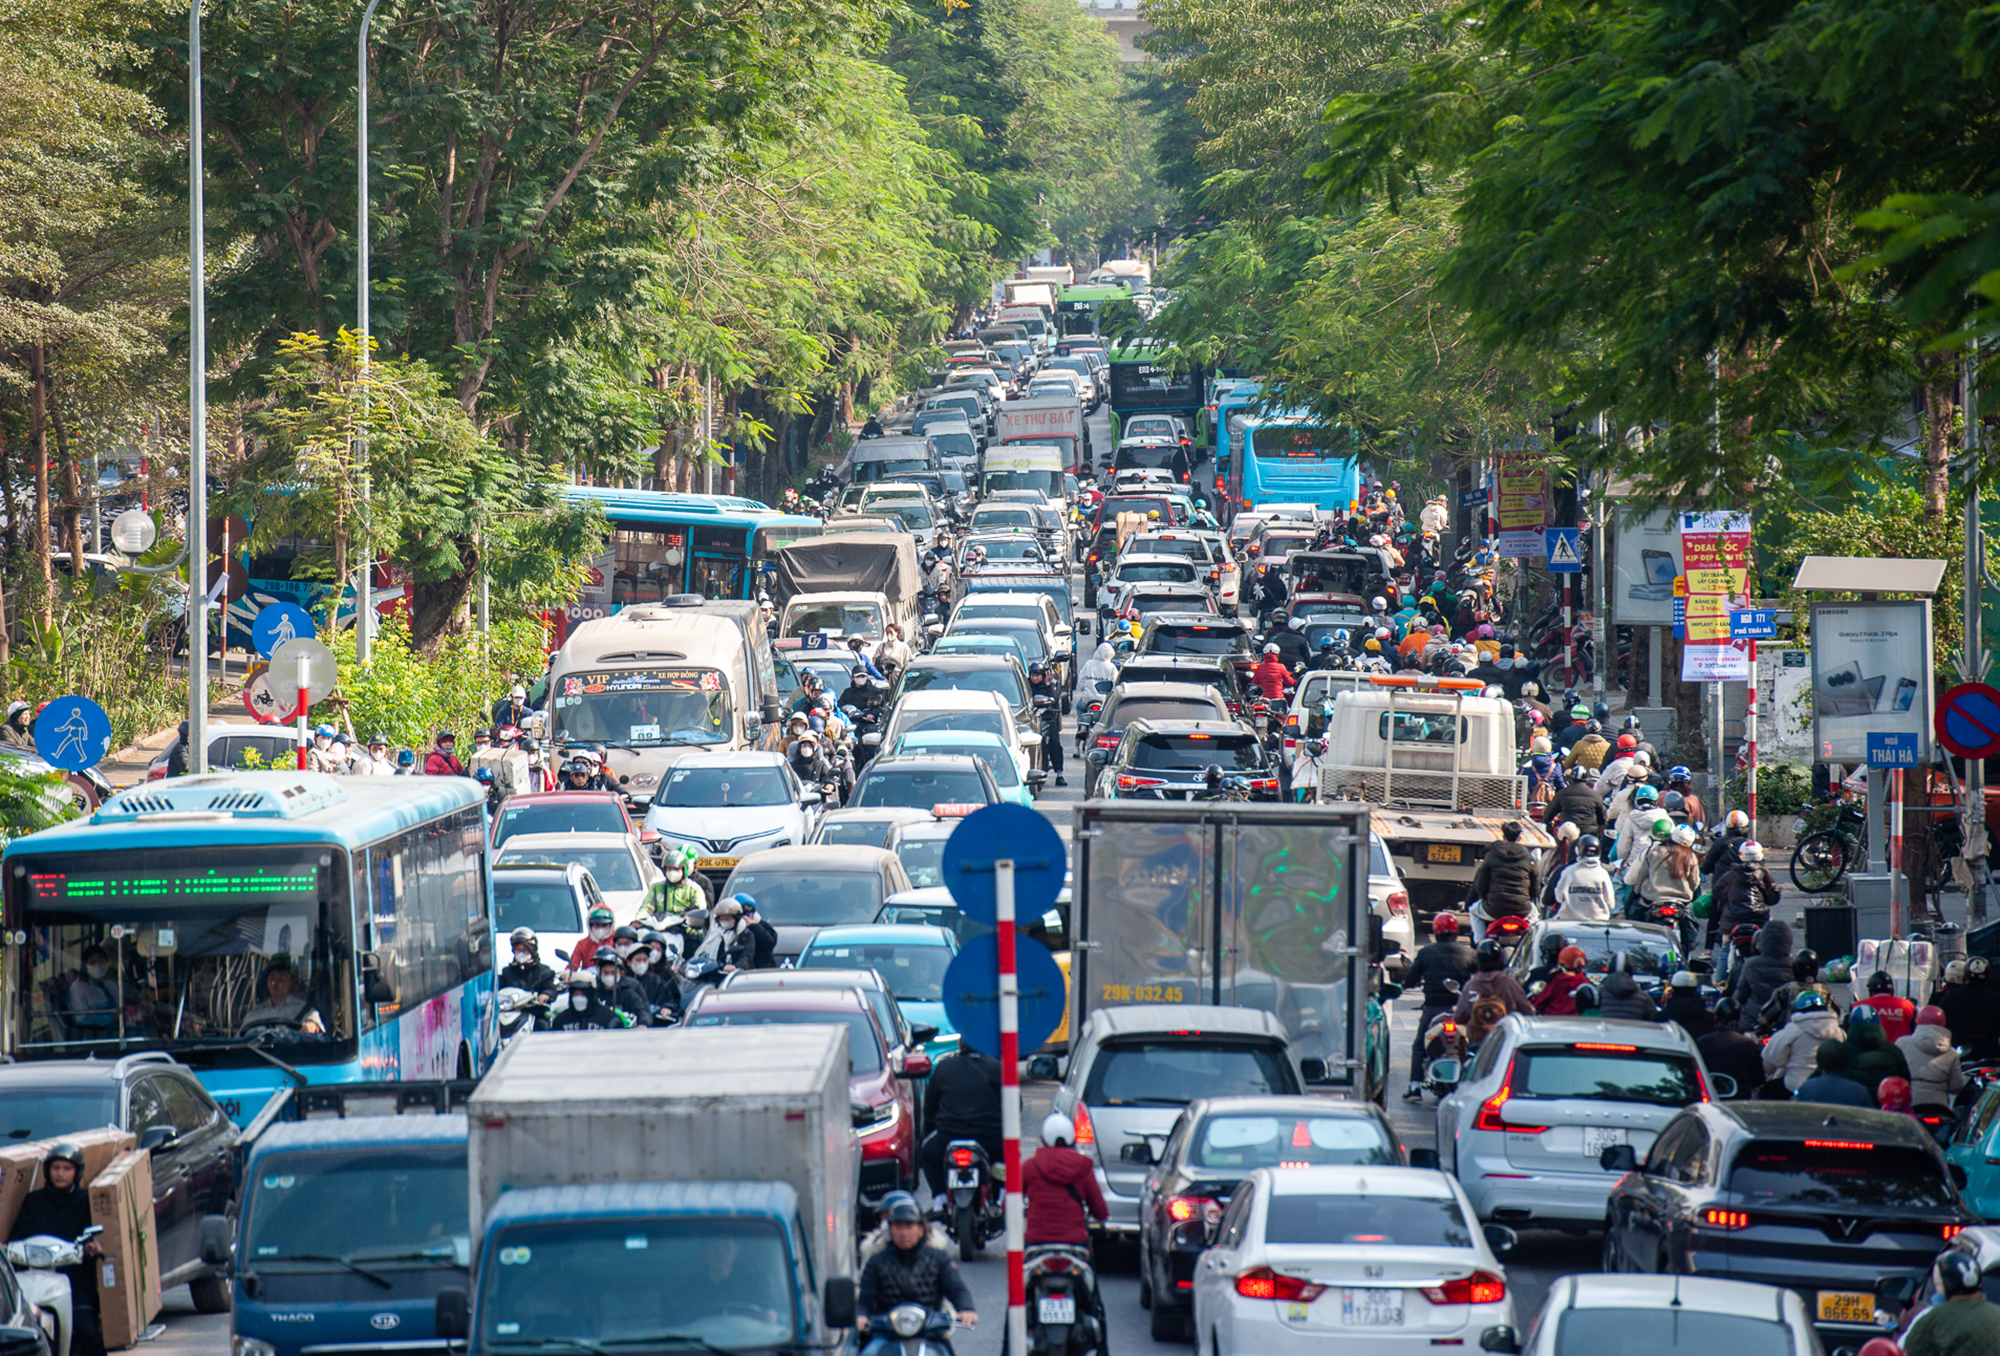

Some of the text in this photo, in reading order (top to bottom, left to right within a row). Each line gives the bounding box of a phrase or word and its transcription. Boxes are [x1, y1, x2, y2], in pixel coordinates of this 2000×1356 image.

[998, 312, 1039, 320] AMBULANCE
[1006, 410, 1073, 426] XE THƯ BÁO
[1694, 540, 1738, 552] DEAL ỐC
[1685, 554, 1699, 563] KỊP
[1700, 554, 1714, 562] ĐẸP
[1740, 611, 1765, 624] NGÕ 171
[587, 674, 610, 684] VIP
[681, 670, 699, 679] ĐỒNG
[606, 683, 642, 691] HYUNDAI
[1885, 735, 1898, 745] NGÕ
[1872, 746, 1913, 763] THÁI HÀ
[938, 804, 960, 815] Taxi
[1102, 984, 1183, 1003] 29K-032.45
[1595, 1129, 1617, 1142] 30G
[1834, 1293, 1860, 1307] 29H
[270, 1313, 315, 1323] THACO
[1824, 1306, 1870, 1321] 866.69
